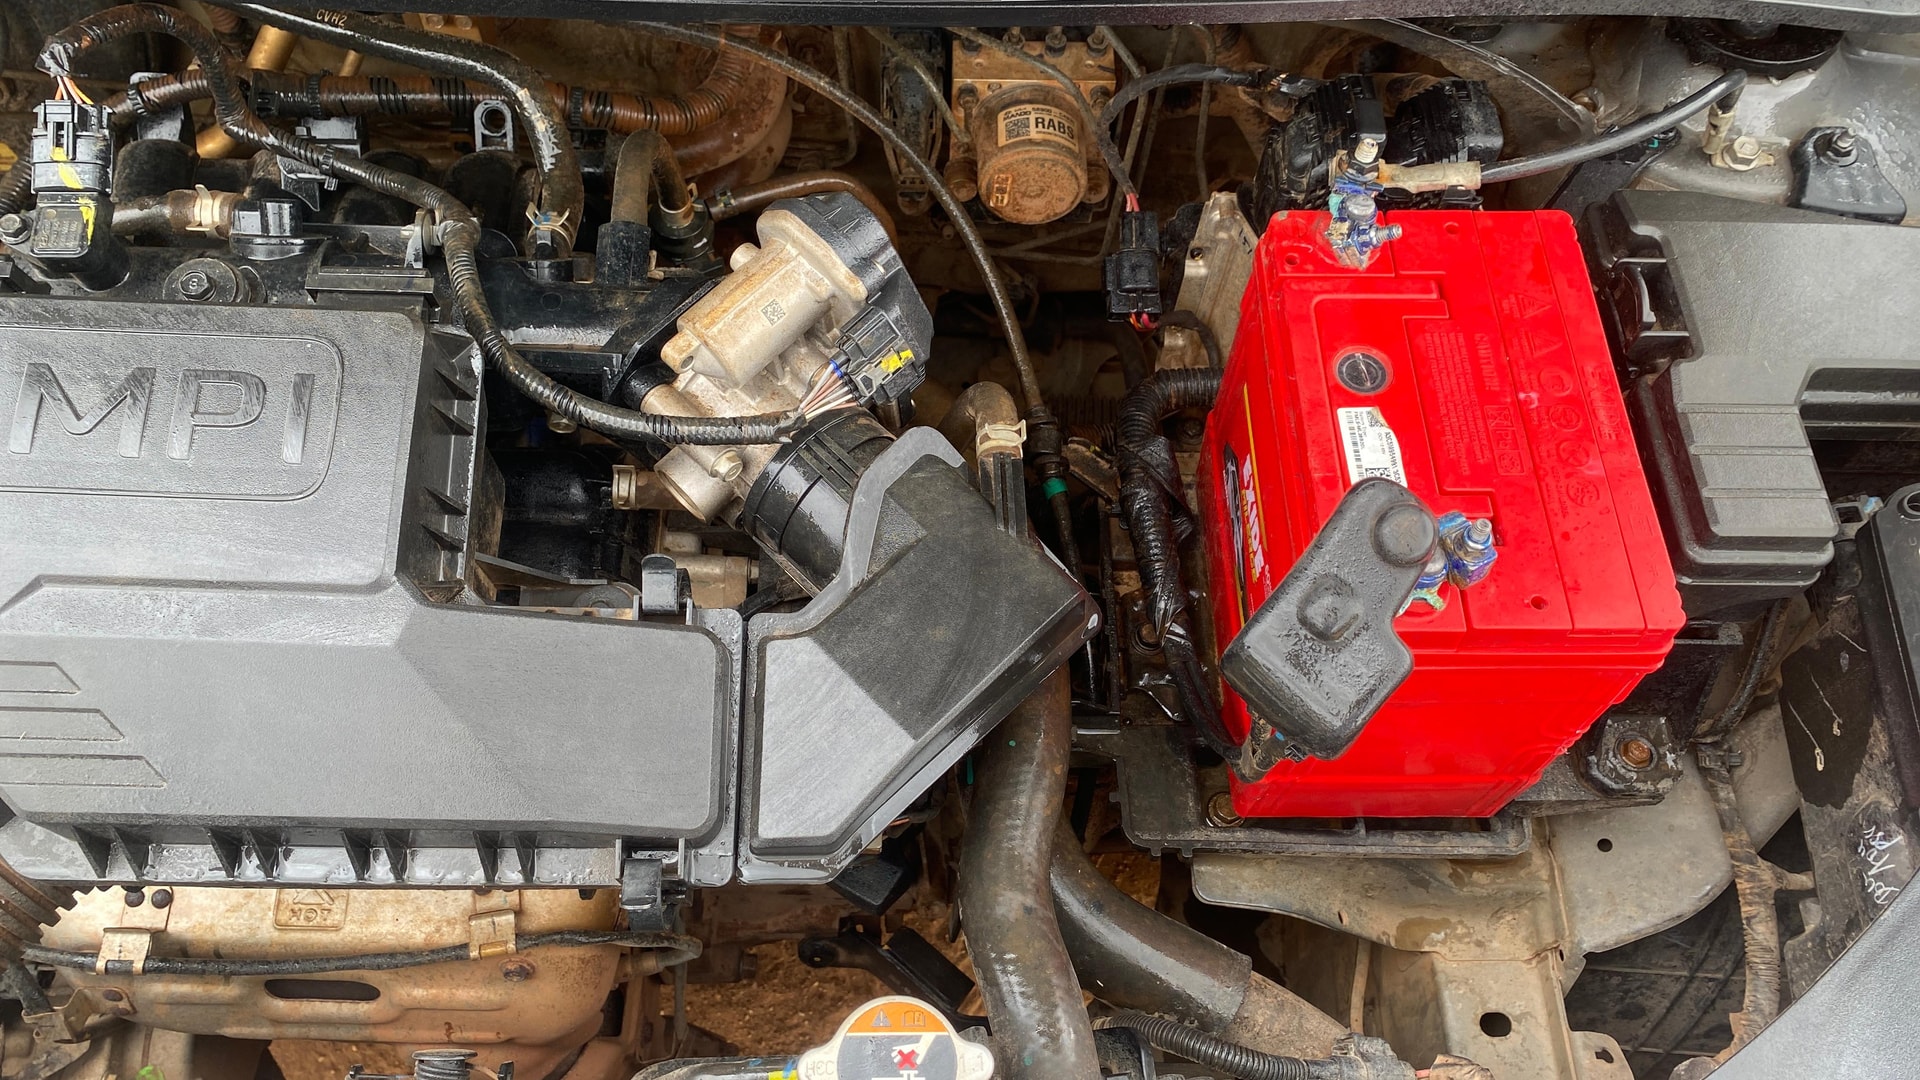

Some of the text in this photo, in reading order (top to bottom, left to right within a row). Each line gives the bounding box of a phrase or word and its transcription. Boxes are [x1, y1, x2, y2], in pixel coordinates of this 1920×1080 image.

[316, 8, 348, 27] CVH2
[1034, 116, 1075, 140] RABS
[9, 362, 316, 465] MPI
[1242, 453, 1265, 578] EXIDE
[288, 907, 333, 923] HOT
